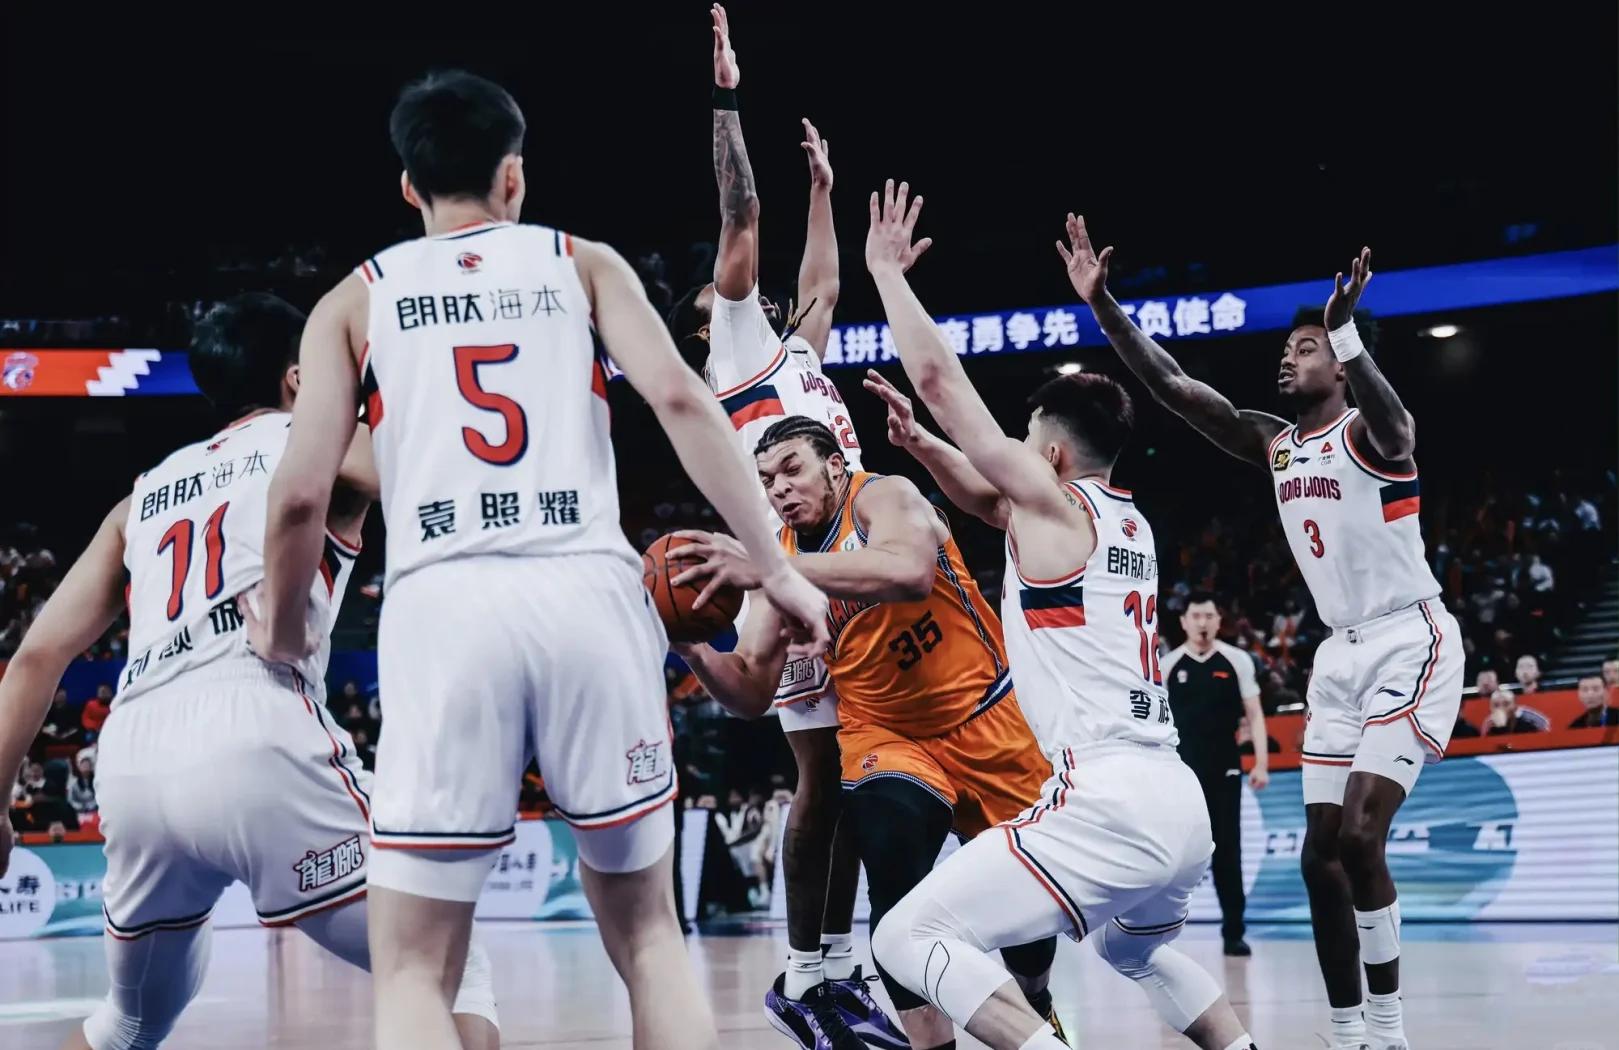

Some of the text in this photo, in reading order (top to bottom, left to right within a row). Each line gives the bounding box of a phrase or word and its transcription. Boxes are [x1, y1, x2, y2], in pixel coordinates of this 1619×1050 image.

[396, 284, 568, 331] 朗肽海本
[453, 343, 528, 466] 5
[829, 415, 860, 449] 2
[1303, 475, 1342, 501] LIONS
[418, 490, 581, 544] 袁照耀
[1303, 518, 1326, 559] 3
[157, 500, 230, 621] 11
[888, 610, 943, 672] 35
